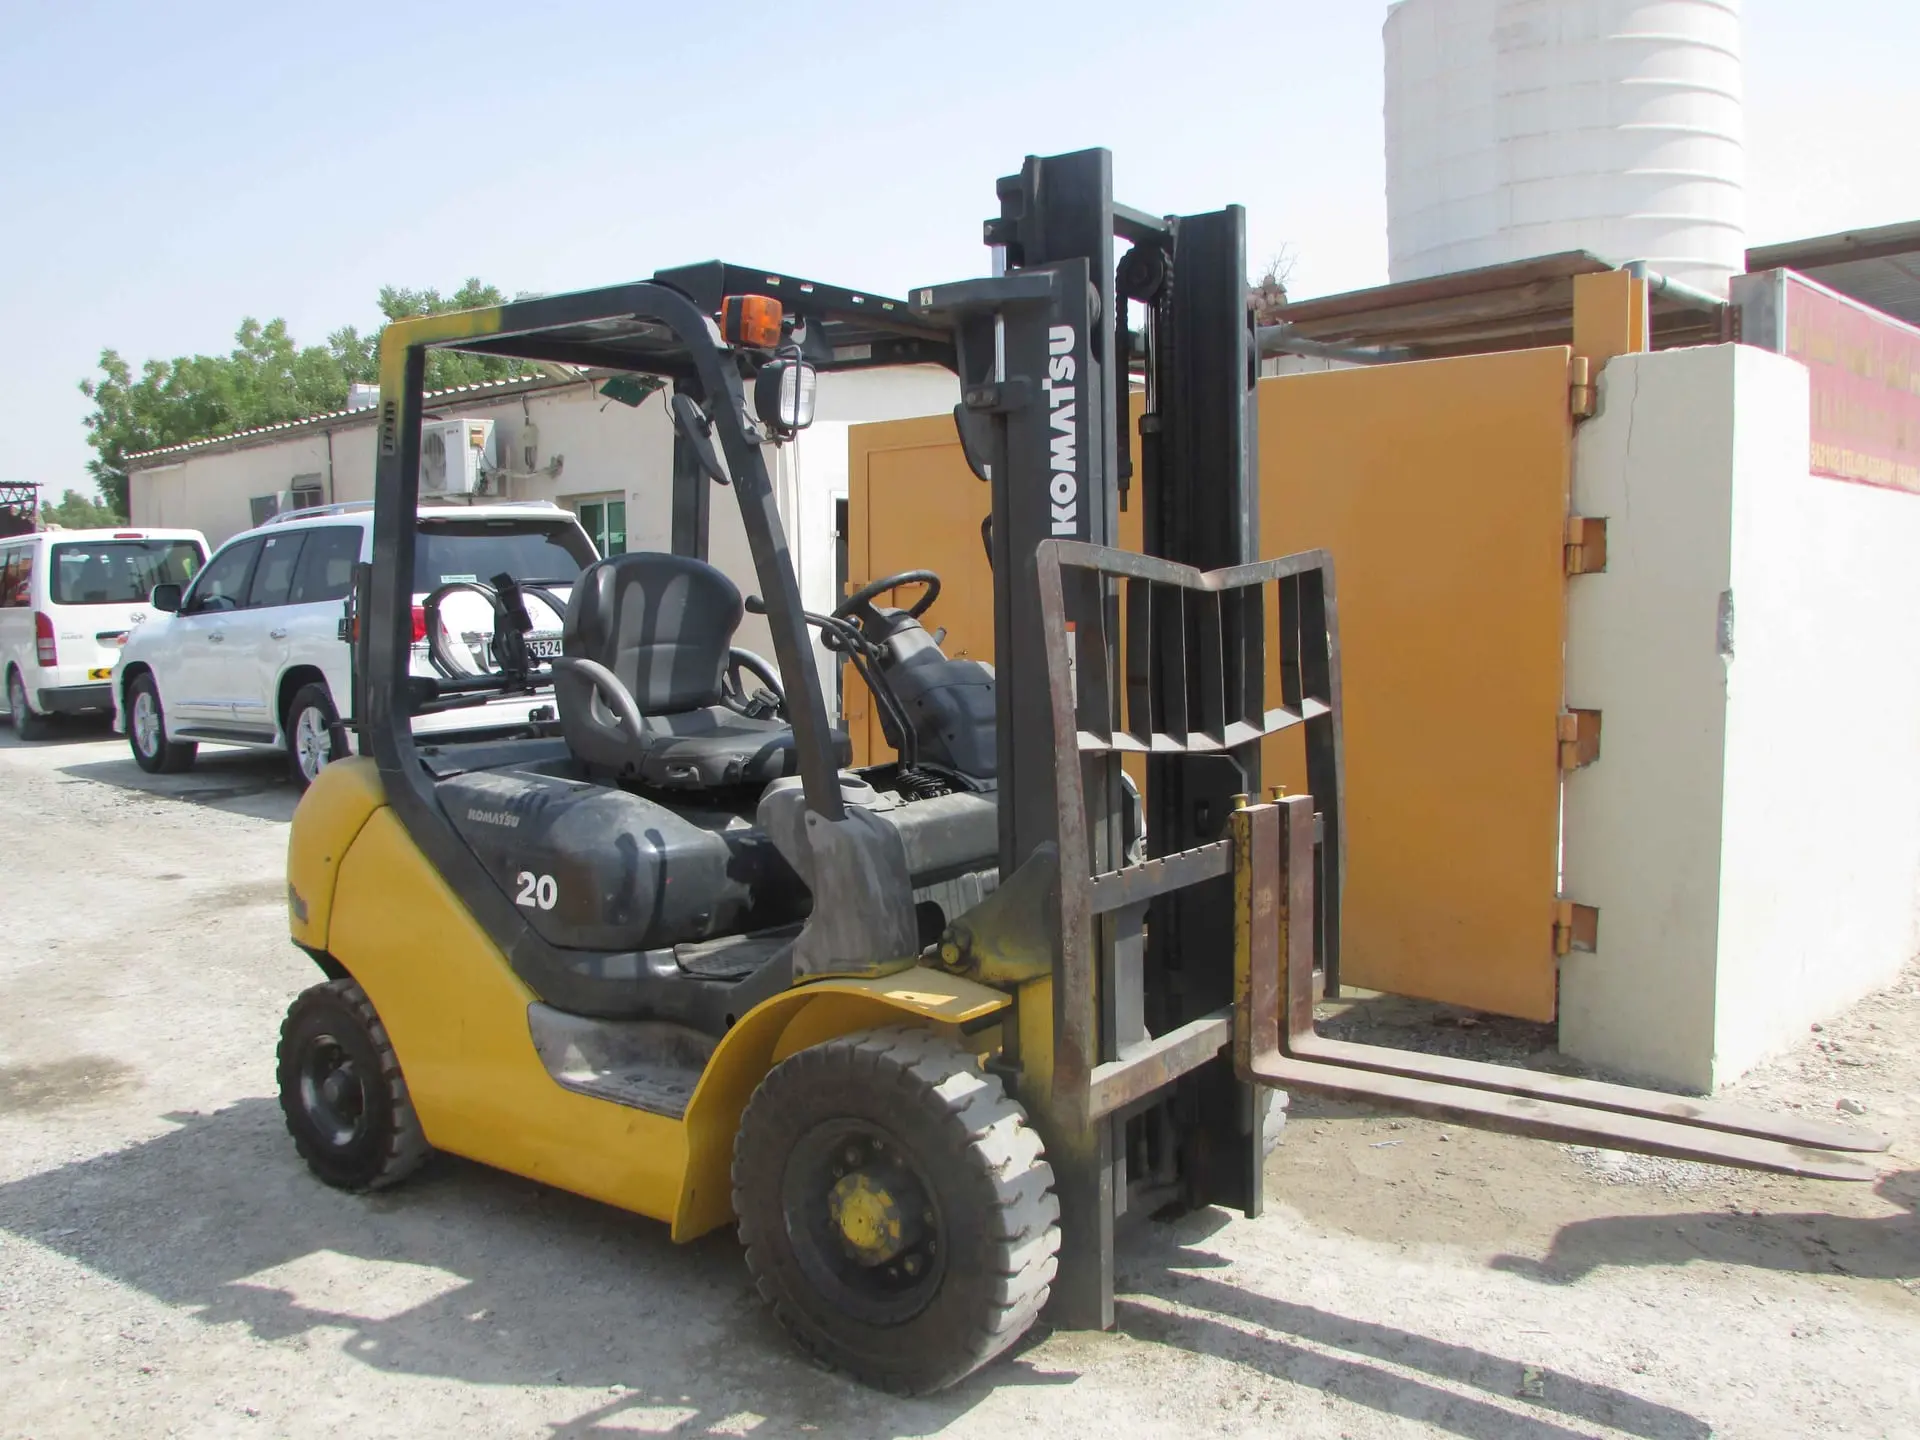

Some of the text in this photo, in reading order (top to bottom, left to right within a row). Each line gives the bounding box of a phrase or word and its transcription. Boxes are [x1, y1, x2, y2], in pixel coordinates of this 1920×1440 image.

[1042, 325, 1077, 535] KOMATSU
[467, 808, 520, 828] KOMATSU
[516, 871, 558, 911] 20
